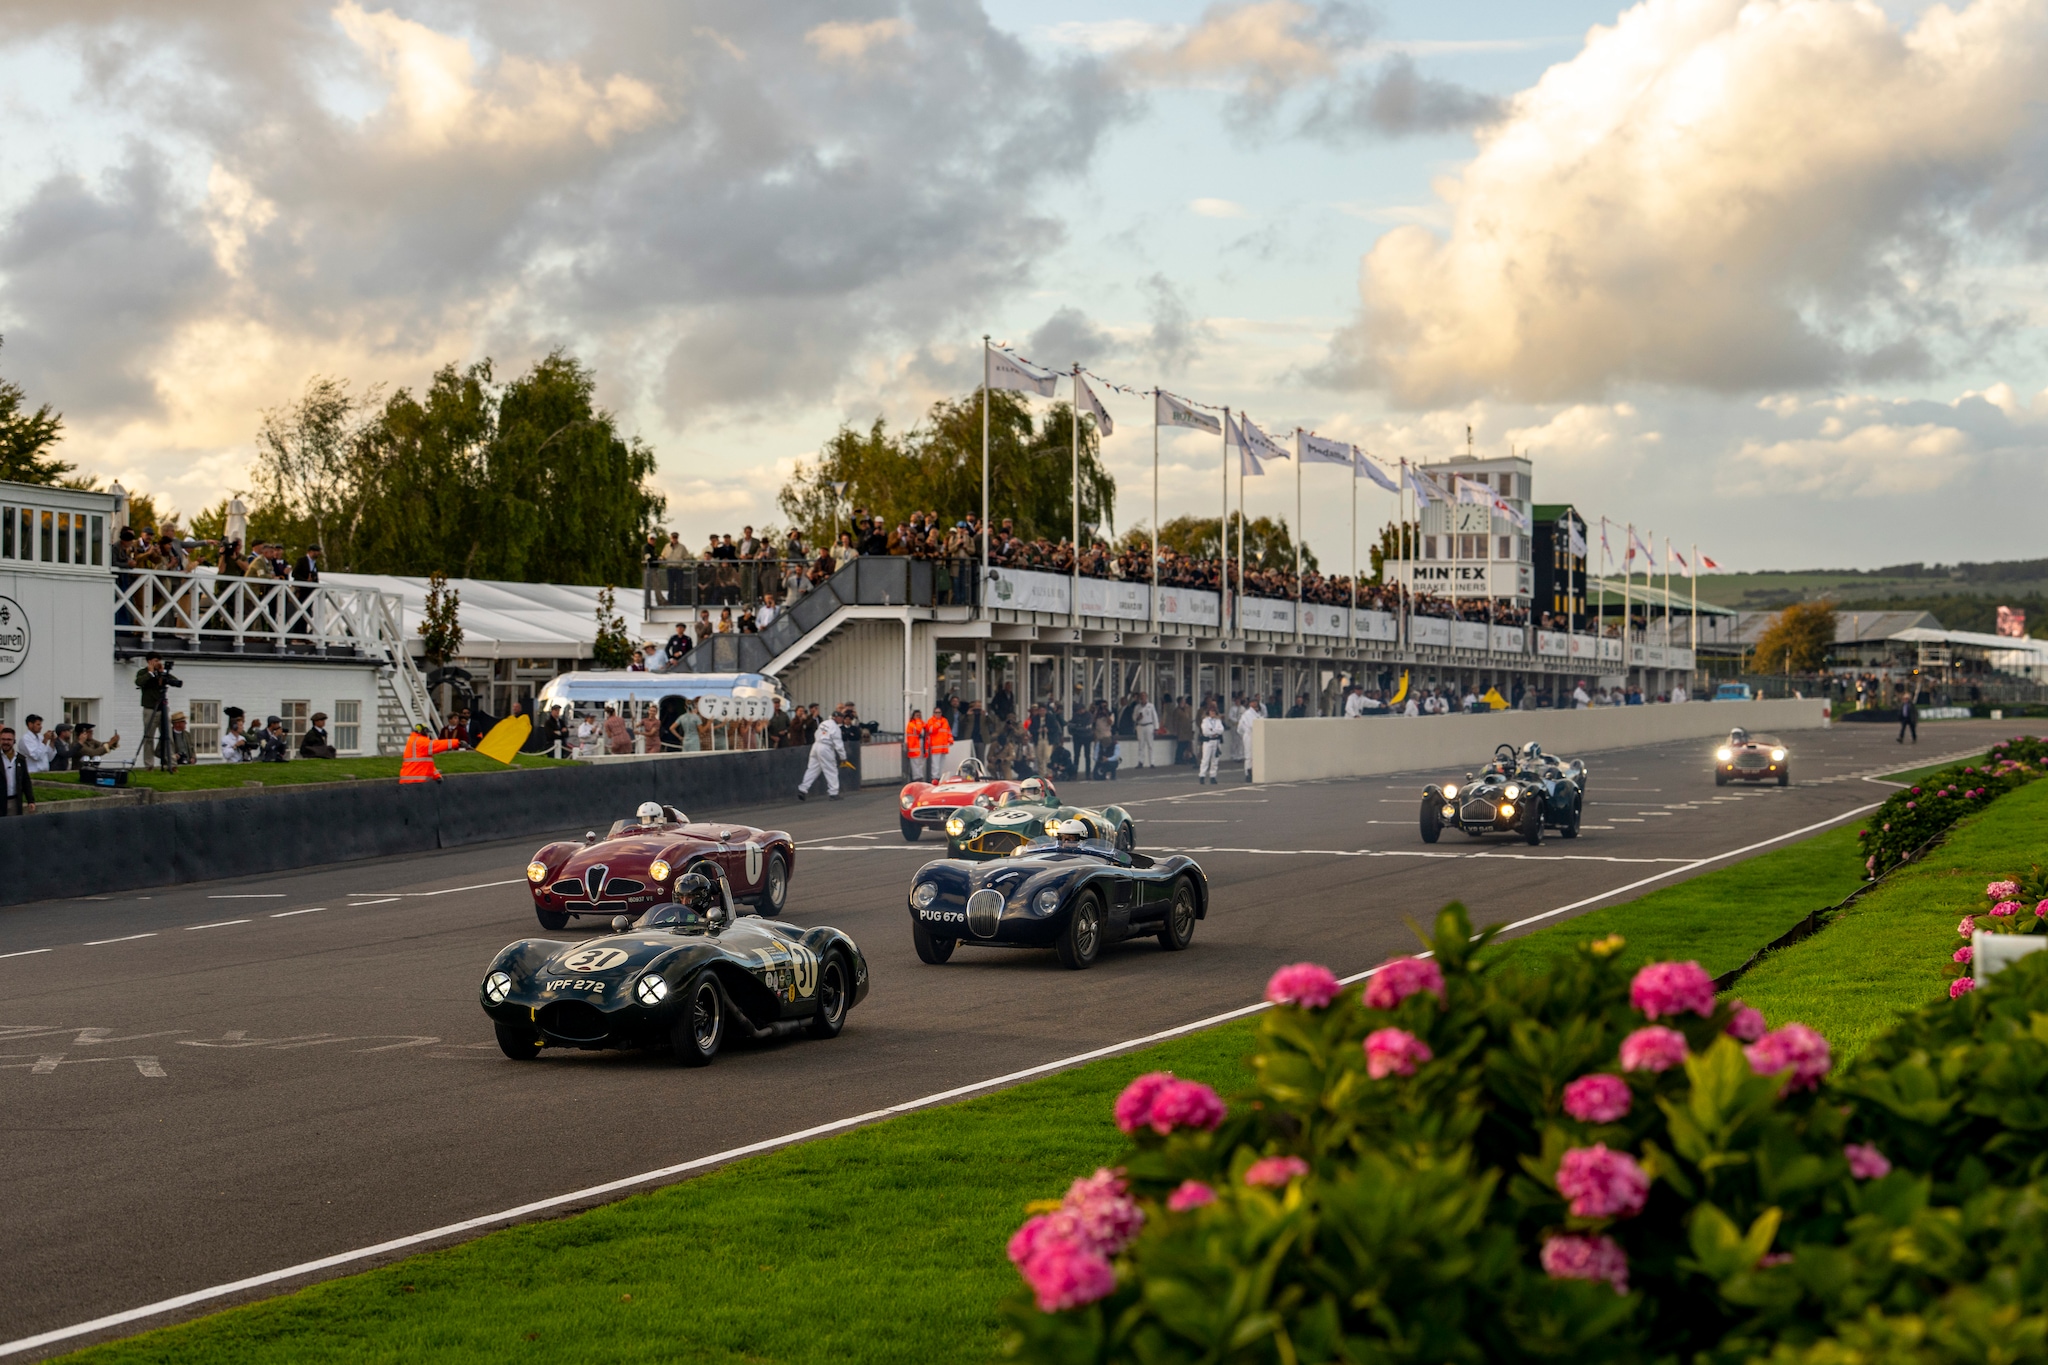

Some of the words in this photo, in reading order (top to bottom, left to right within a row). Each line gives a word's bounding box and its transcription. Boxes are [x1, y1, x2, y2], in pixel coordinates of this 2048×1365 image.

[1413, 567, 1486, 579] MINTEX
[1413, 583, 1446, 591] BRAKE
[1073, 630, 1080, 640] 2
[1113, 632, 1120, 643] 3
[1151, 635, 1158, 645] 4
[1187, 637, 1193, 648] 5
[1220, 640, 1227, 650] 6
[1267, 643, 1273, 652] 7
[1296, 645, 1303, 654] 8
[1325, 648, 1331, 656] 9
[1346, 649, 1357, 658] 10
[1372, 651, 1381, 659] 11
[1394, 652, 1403, 661] 12
[1426, 655, 1436, 663] 14
[1448, 657, 1457, 665] 15
[1466, 658, 1476, 666] 16
[1485, 659, 1494, 667] 17
[708, 704, 714, 714] 7
[749, 707, 754, 716] 3
[920, 910, 941, 921] PUG
[943, 912, 964, 922] 676
[571, 950, 621, 967] 31
[792, 948, 813, 989] 31
[546, 980, 573, 991] VPF
[573, 980, 605, 993] 272
